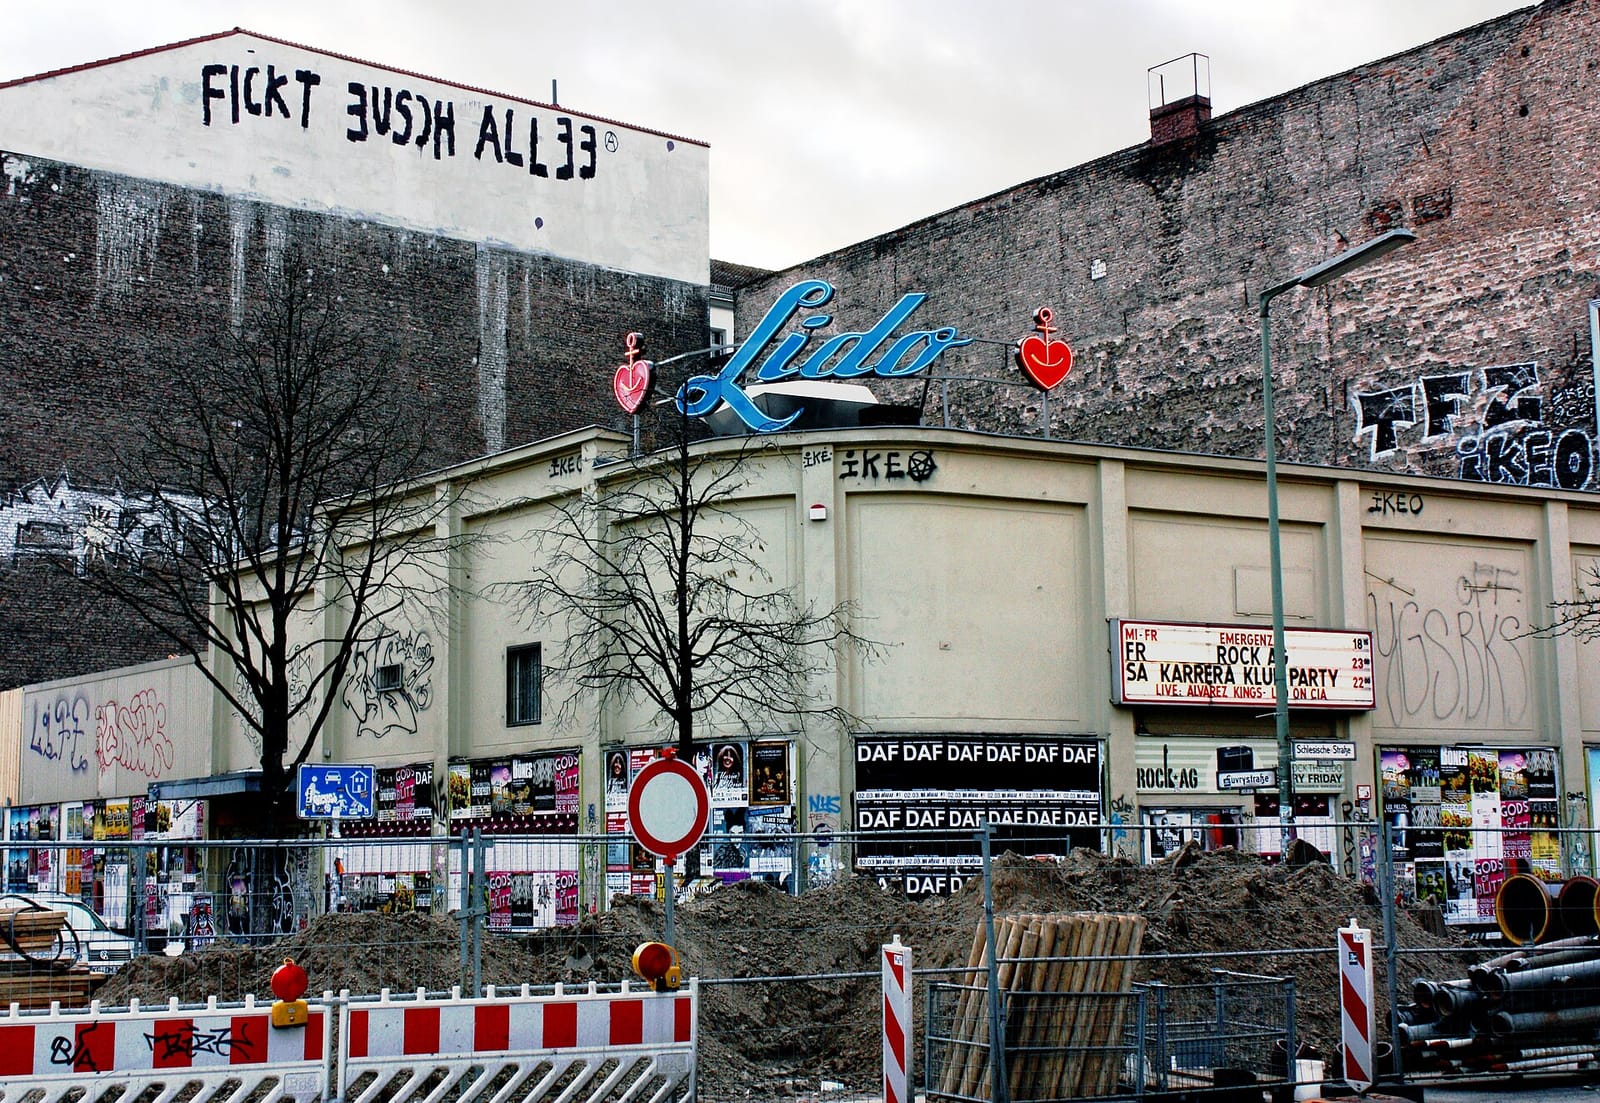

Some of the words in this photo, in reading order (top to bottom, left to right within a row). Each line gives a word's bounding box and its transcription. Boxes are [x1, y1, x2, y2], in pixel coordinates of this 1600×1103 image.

[201, 64, 321, 128] FICKT
[676, 279, 973, 432] Lido
[1126, 642, 1146, 660] FR
[1217, 645, 1261, 665] ROCK
[1127, 662, 1148, 681] SA
[1160, 663, 1236, 684] KARRERA
[1243, 666, 1277, 686] KLU
[1289, 668, 1338, 687] PARTY
[1187, 684, 1228, 698] ALVAREZ
[1293, 688, 1306, 700] ON
[1310, 688, 1327, 700] CIA
[857, 744, 899, 762] DAF
[903, 744, 943, 761] DAF
[947, 745, 983, 761] DAF
[986, 745, 1021, 762] DAF
[1025, 746, 1058, 762] DAF
[1062, 746, 1096, 763] DAF
[1296, 744, 1330, 754] Schlesische
[555, 756, 578, 770] GODS
[416, 771, 432, 784] DAF
[555, 774, 579, 791] BLITZ
[1308, 774, 1342, 783] FRIDAY
[988, 809, 1023, 824] DAF
[1027, 810, 1061, 825] DAF
[1501, 802, 1529, 817] GODS
[859, 810, 901, 828] DAF
[905, 810, 945, 827] DAF
[949, 811, 985, 828] DAF
[1065, 811, 1098, 826] DAF
[1506, 816, 1515, 824] OF
[1474, 859, 1504, 875] GODS
[490, 873, 511, 889] GODS
[555, 873, 578, 889] GODS
[906, 876, 946, 894] DAF
